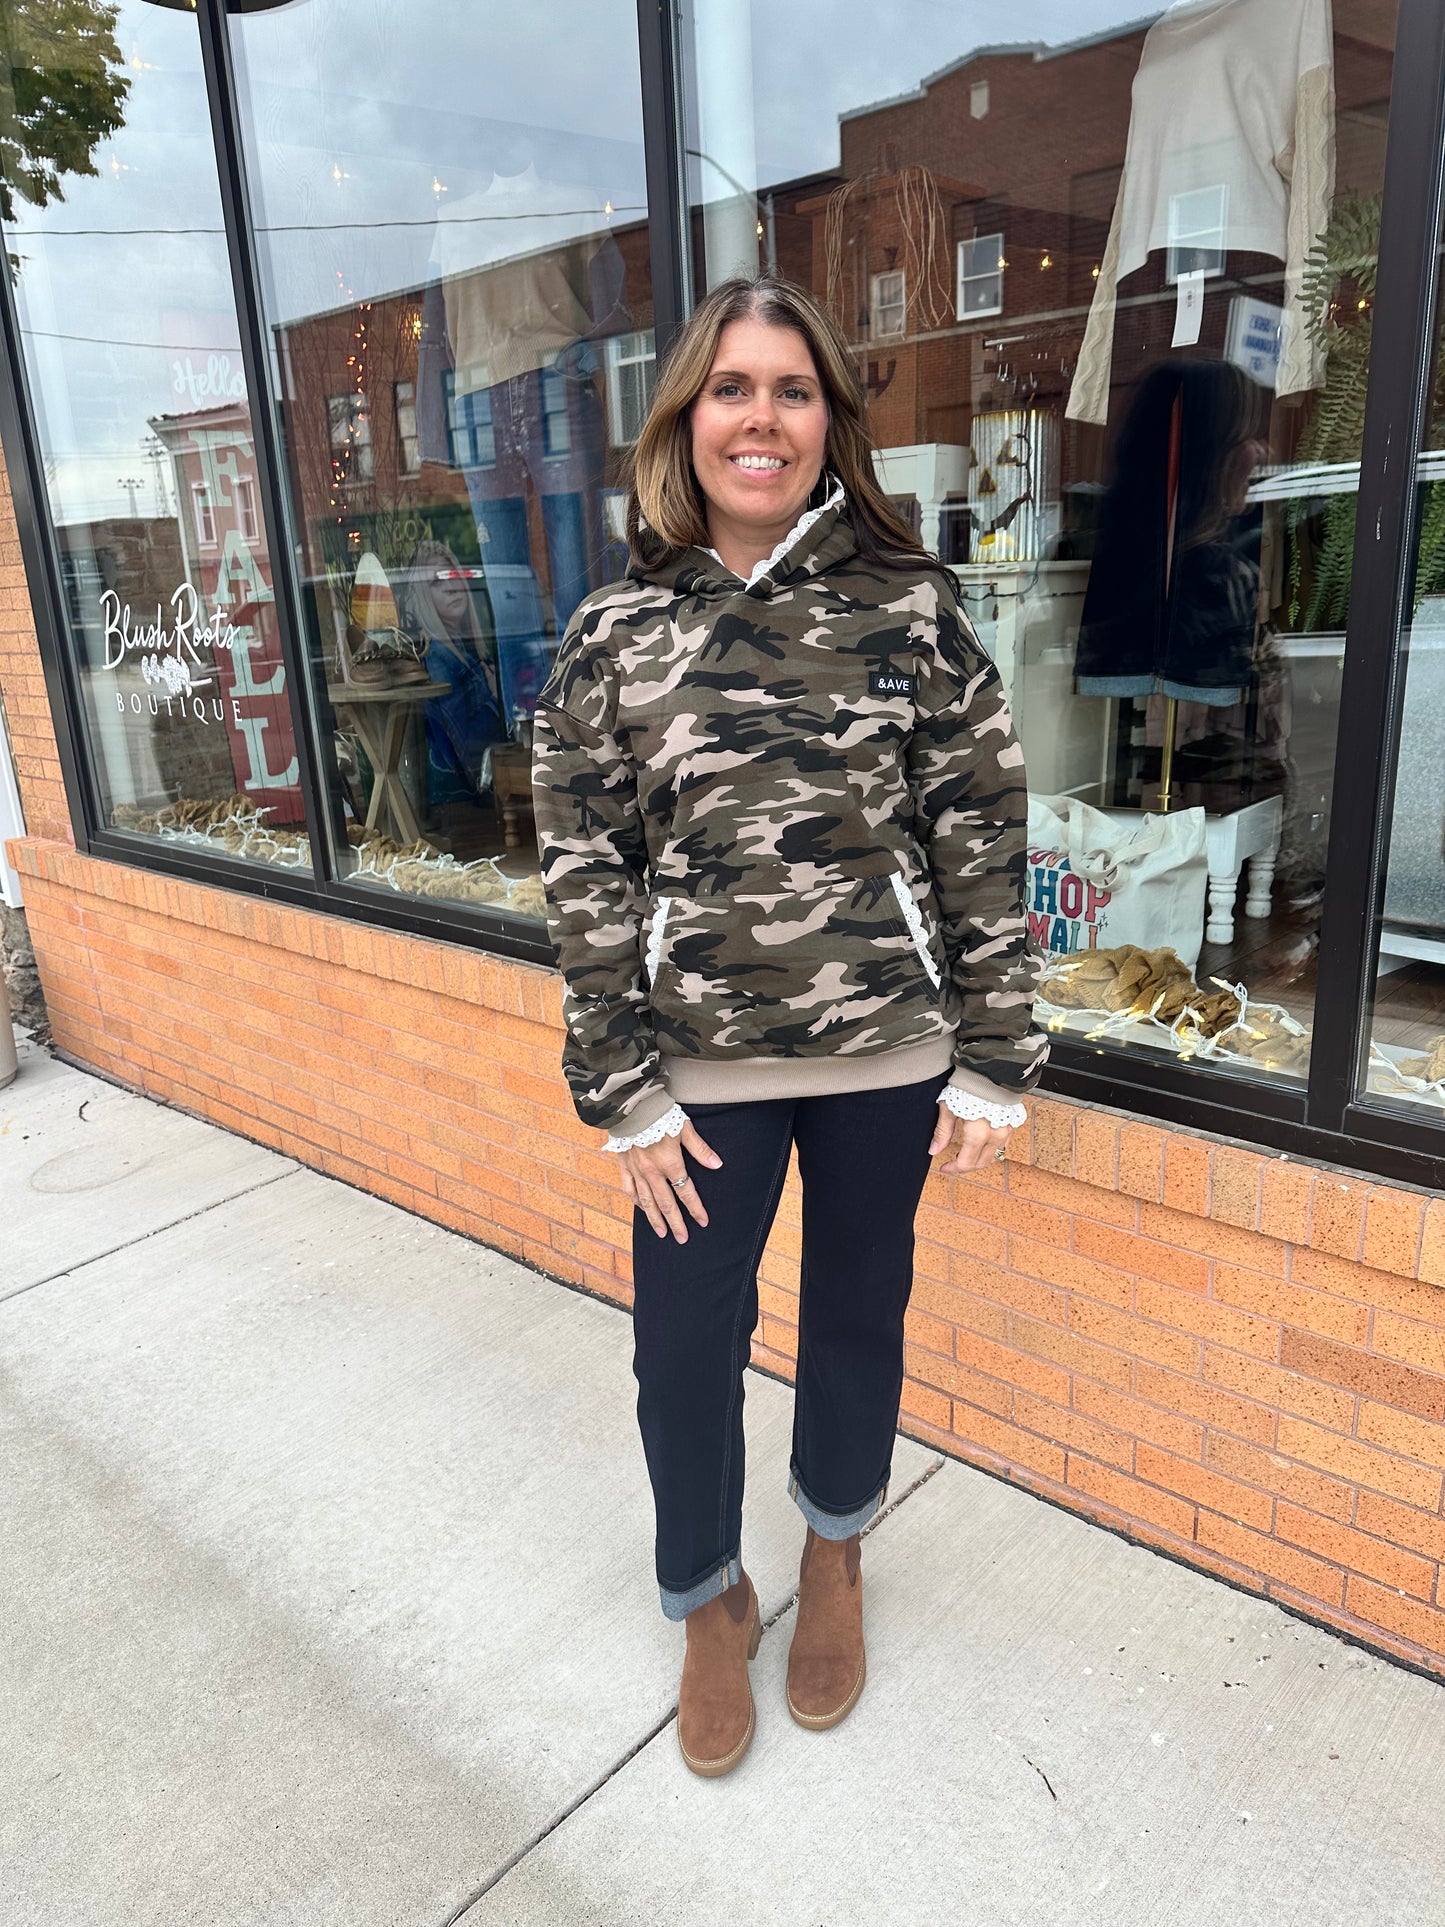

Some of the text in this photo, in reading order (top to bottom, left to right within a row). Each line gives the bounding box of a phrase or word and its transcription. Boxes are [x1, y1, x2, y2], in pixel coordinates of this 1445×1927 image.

[173, 354, 247, 405] Hello
[99, 582, 241, 670] Blush Roots
[187, 430, 300, 790] FALL
[877, 677, 910, 691] &AVE
[115, 692, 243, 725] BOUTIQUE
[1027, 911, 1099, 955] MALL
